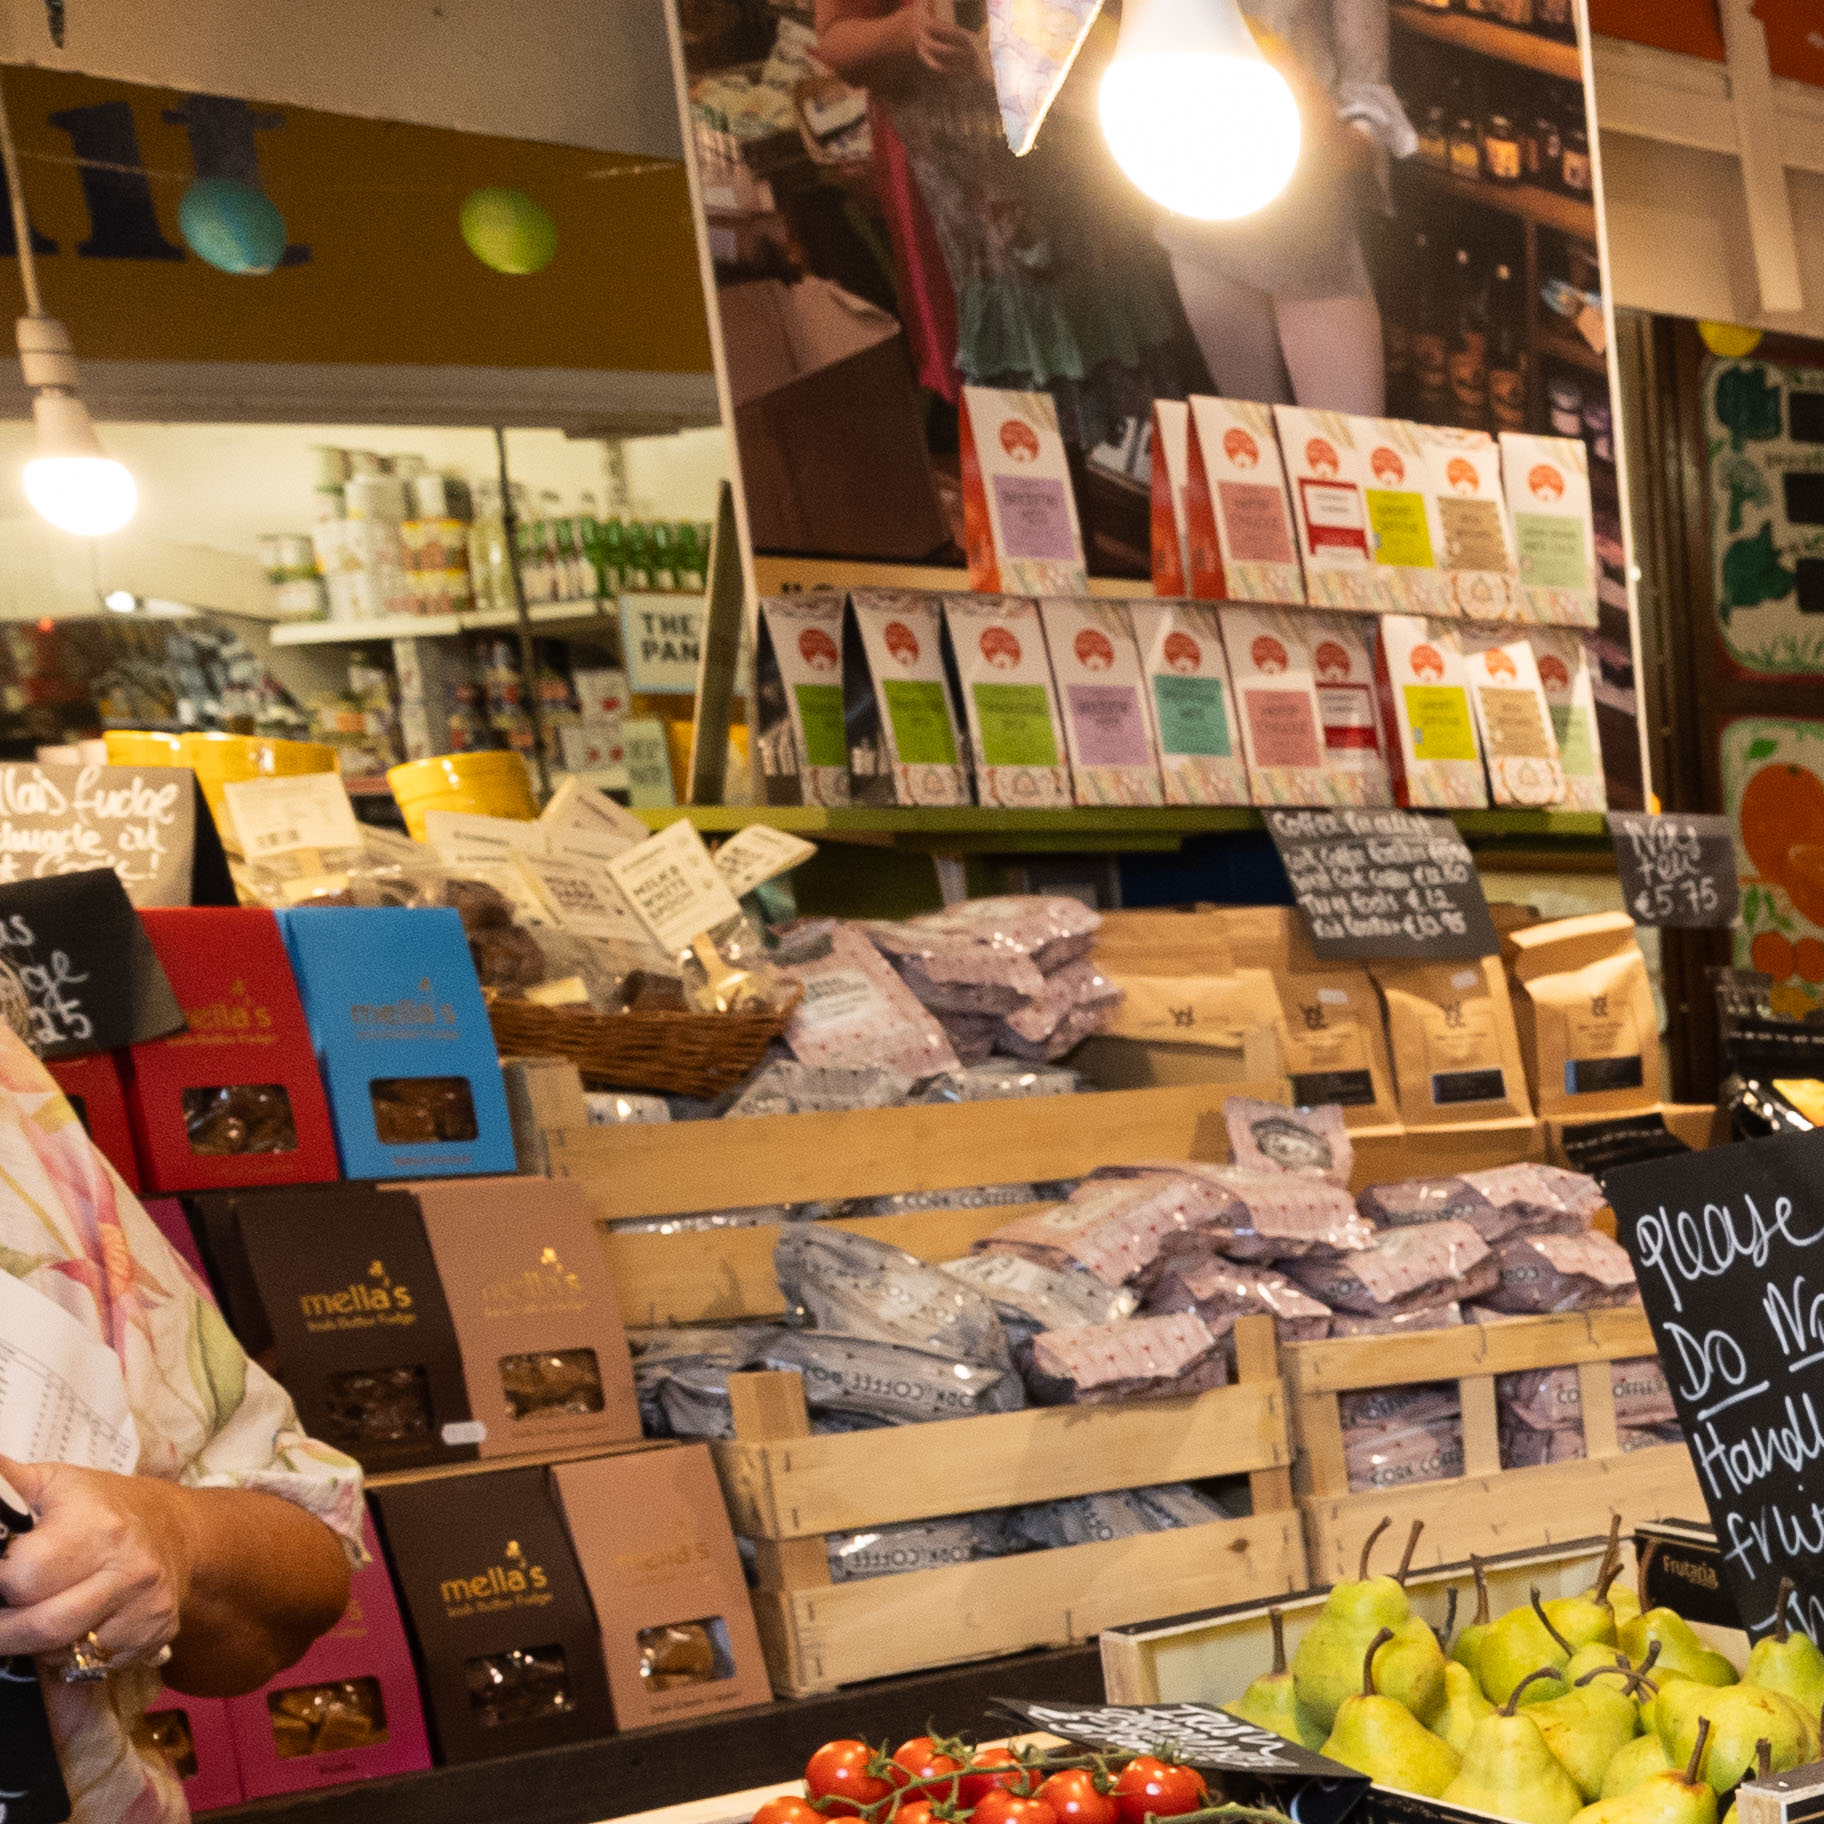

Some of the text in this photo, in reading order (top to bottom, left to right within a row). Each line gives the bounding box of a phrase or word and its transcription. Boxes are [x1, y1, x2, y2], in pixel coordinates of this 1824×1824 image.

[187, 1003, 272, 1030] ella's
[351, 998, 458, 1026] mella's
[300, 1283, 414, 1318] mella's
[1663, 1322, 1747, 1401] Do
[440, 1565, 549, 1602] mella's
[1663, 1555, 1718, 1590] Frutaria
